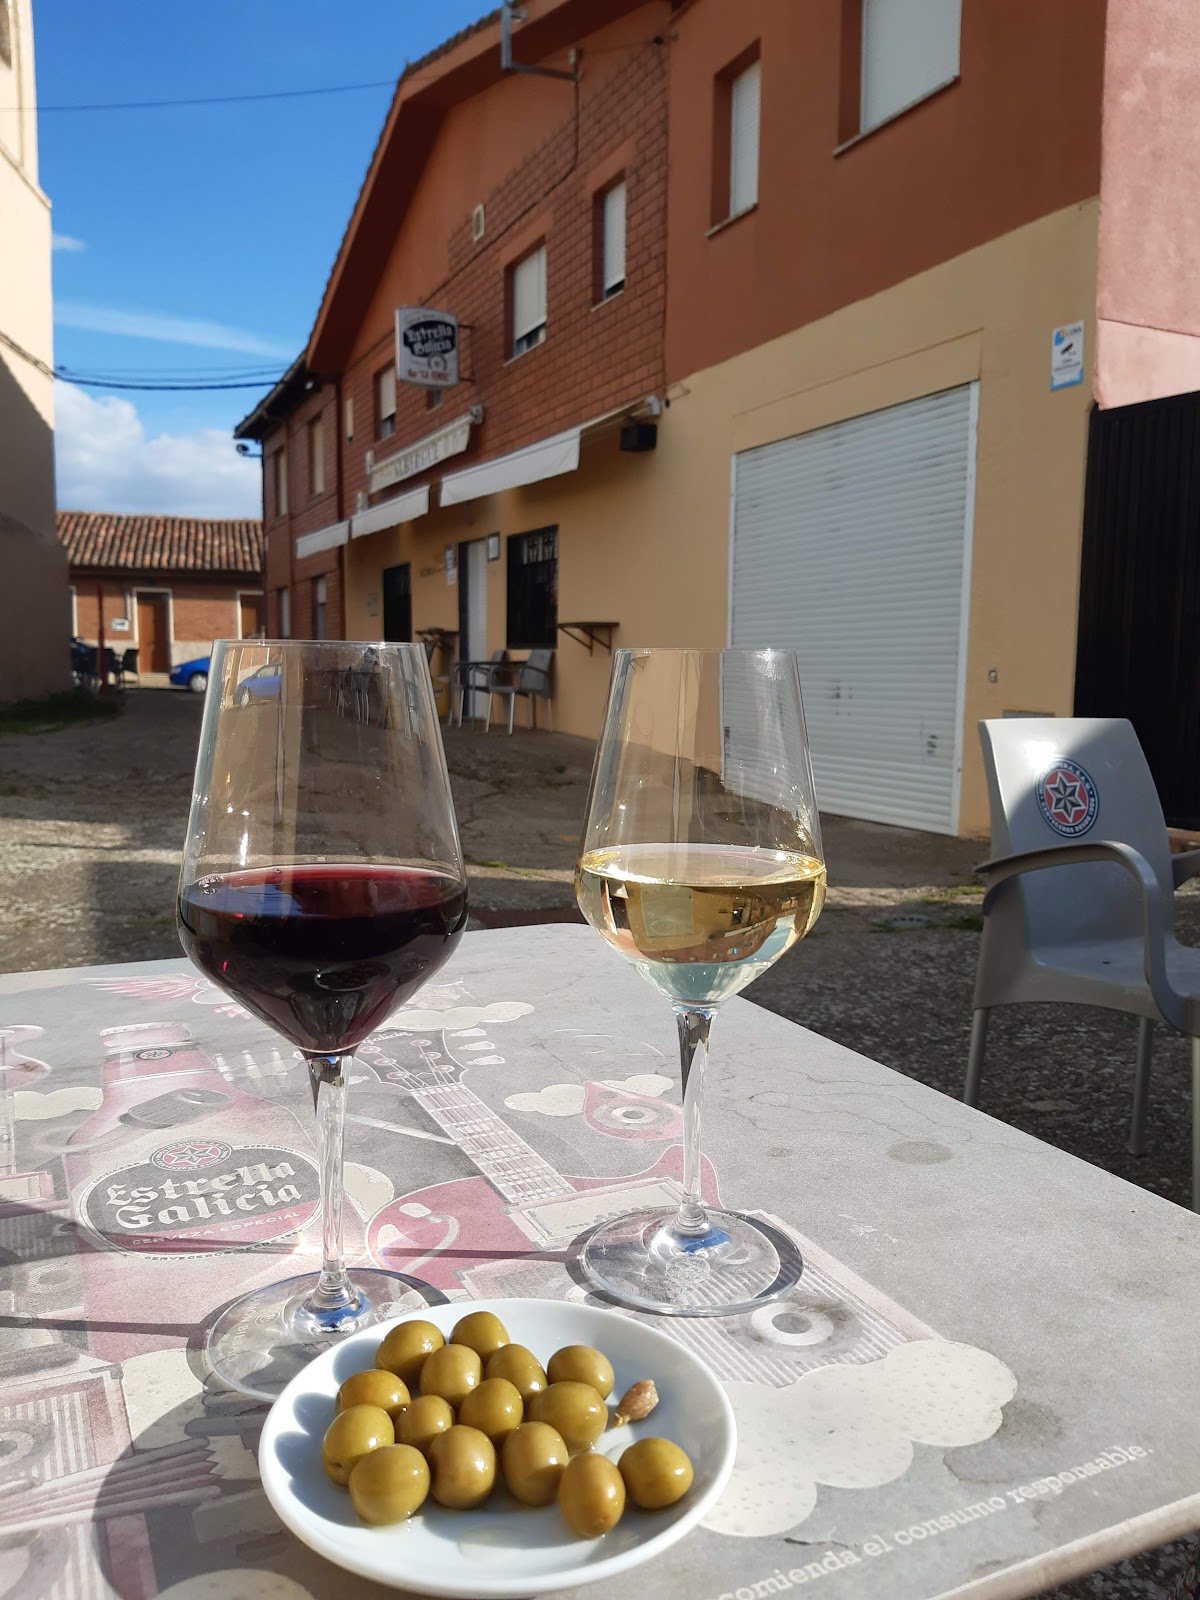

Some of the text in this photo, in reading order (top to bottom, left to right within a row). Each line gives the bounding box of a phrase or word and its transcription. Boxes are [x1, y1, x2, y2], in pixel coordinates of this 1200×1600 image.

[106, 1161, 296, 1206] Estrella
[115, 1184, 302, 1229] Galicia
[132, 1211, 301, 1245] CERVEZA ESPECIAL
[863, 1533, 894, 1557] el
[894, 1495, 1008, 1546] consumo
[1006, 1441, 1156, 1506] responsable.
